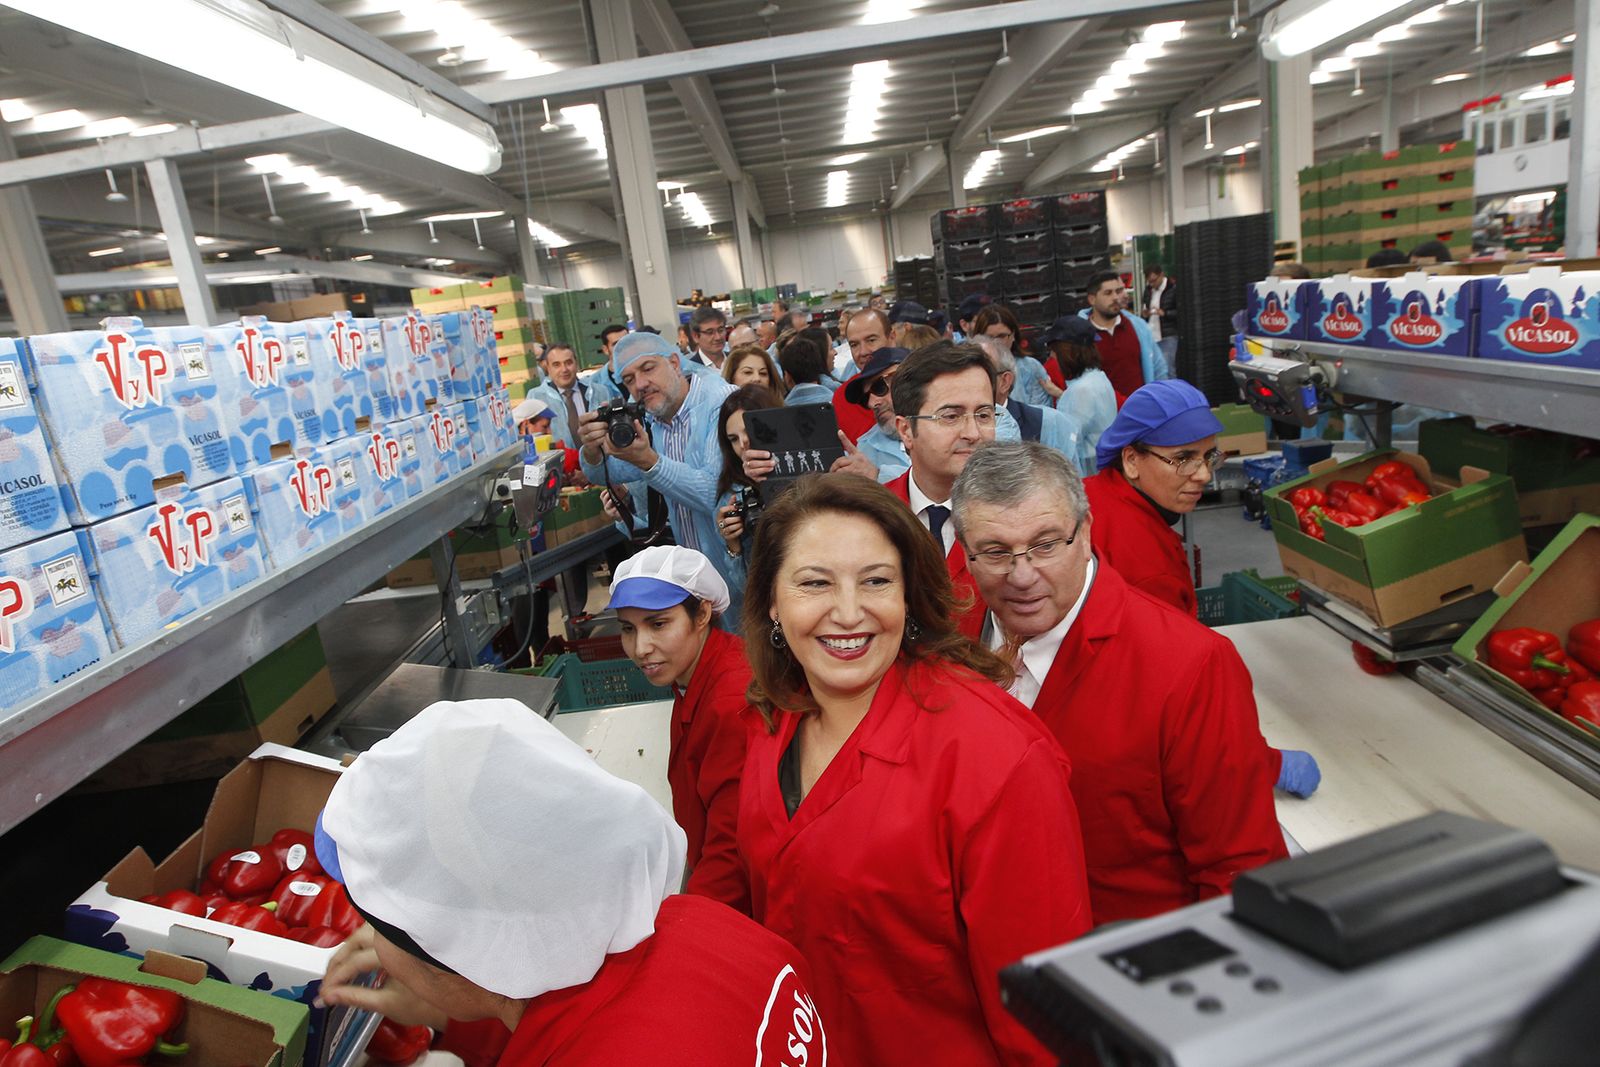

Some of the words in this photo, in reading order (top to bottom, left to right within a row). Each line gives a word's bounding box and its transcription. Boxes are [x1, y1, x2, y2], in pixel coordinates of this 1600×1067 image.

[96, 334, 167, 400] VyP
[237, 329, 282, 381] VyP
[331, 322, 362, 366] VyP
[369, 434, 398, 477] VyP
[291, 461, 332, 512] VyP
[149, 504, 212, 569] VyP
